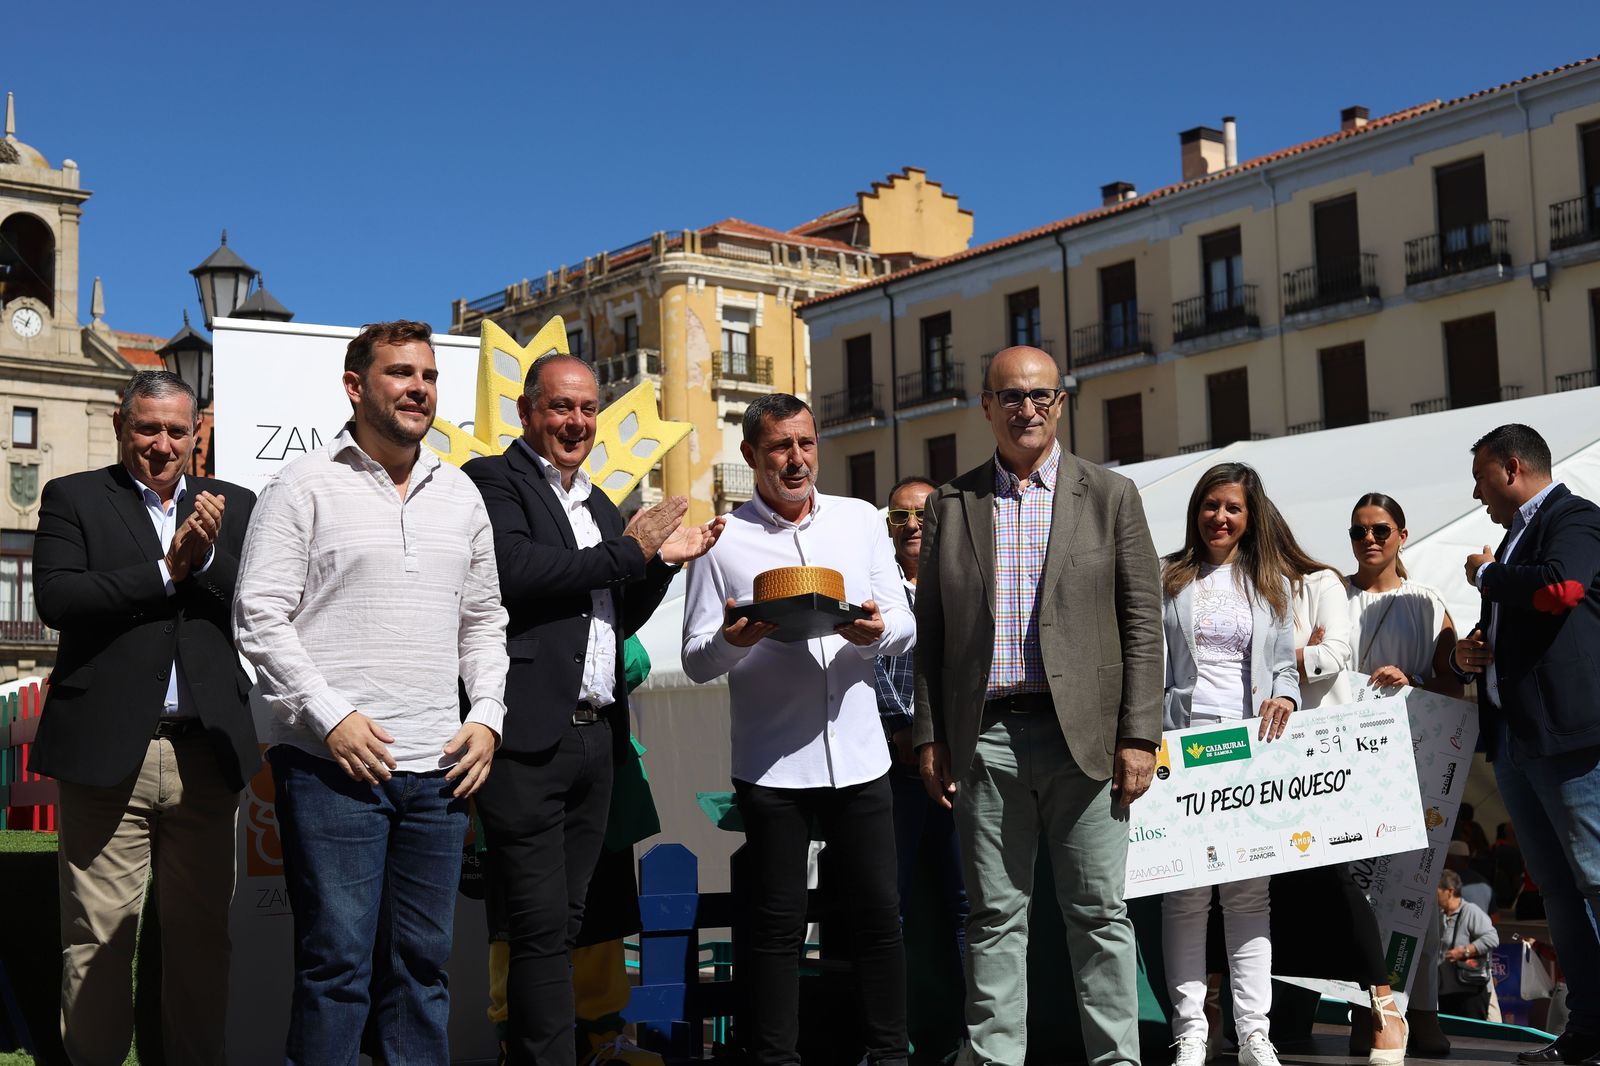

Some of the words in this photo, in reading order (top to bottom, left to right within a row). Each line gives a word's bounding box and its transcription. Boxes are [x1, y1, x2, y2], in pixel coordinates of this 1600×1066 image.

[1315, 728, 1329, 736] 0000
[1319, 734, 1342, 754] 59
[1210, 783, 1255, 813] PESO
[1259, 778, 1284, 805] EN
[1248, 851, 1277, 862] ZAMORA
[1129, 863, 1170, 881] ZAMORA
[1171, 858, 1184, 873] 10
